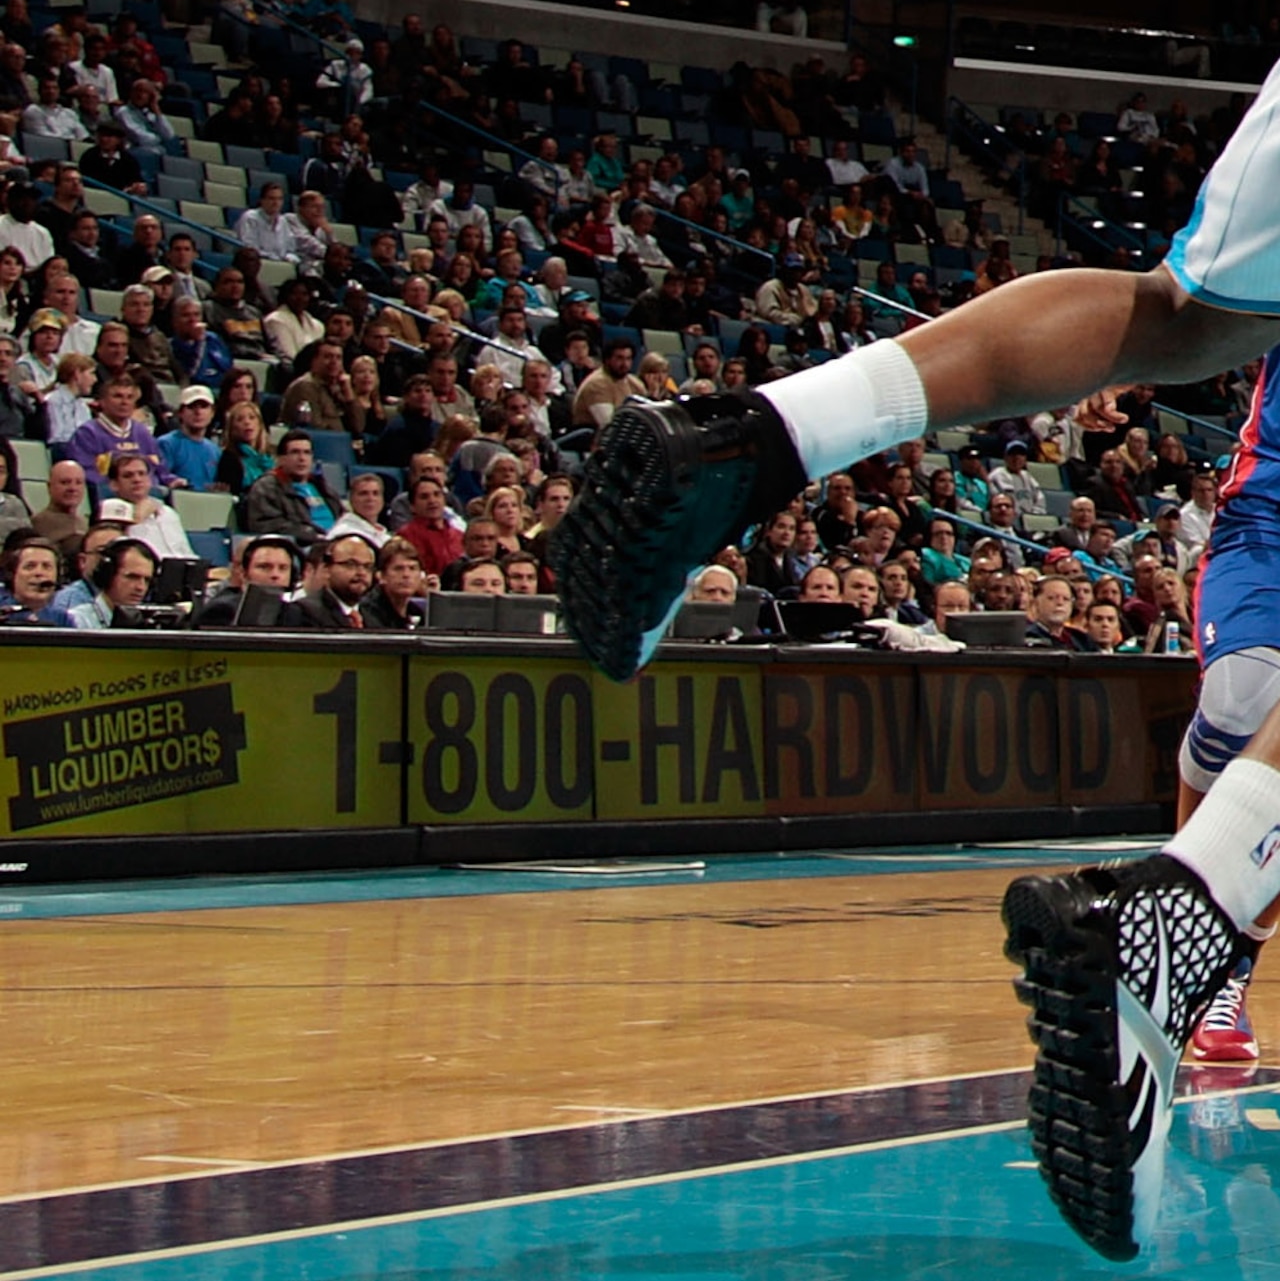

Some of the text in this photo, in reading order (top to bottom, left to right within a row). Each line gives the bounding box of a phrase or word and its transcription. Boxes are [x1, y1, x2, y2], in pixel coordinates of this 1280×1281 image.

[3, 687, 83, 717] HARDWOOD
[89, 675, 147, 699] FLOORS
[152, 669, 181, 689] FOR
[63, 698, 187, 754] LUMBER
[313, 670, 1111, 816] 1-800-HARDWOOD
[40, 768, 224, 821] www.lumberliquidators.com
